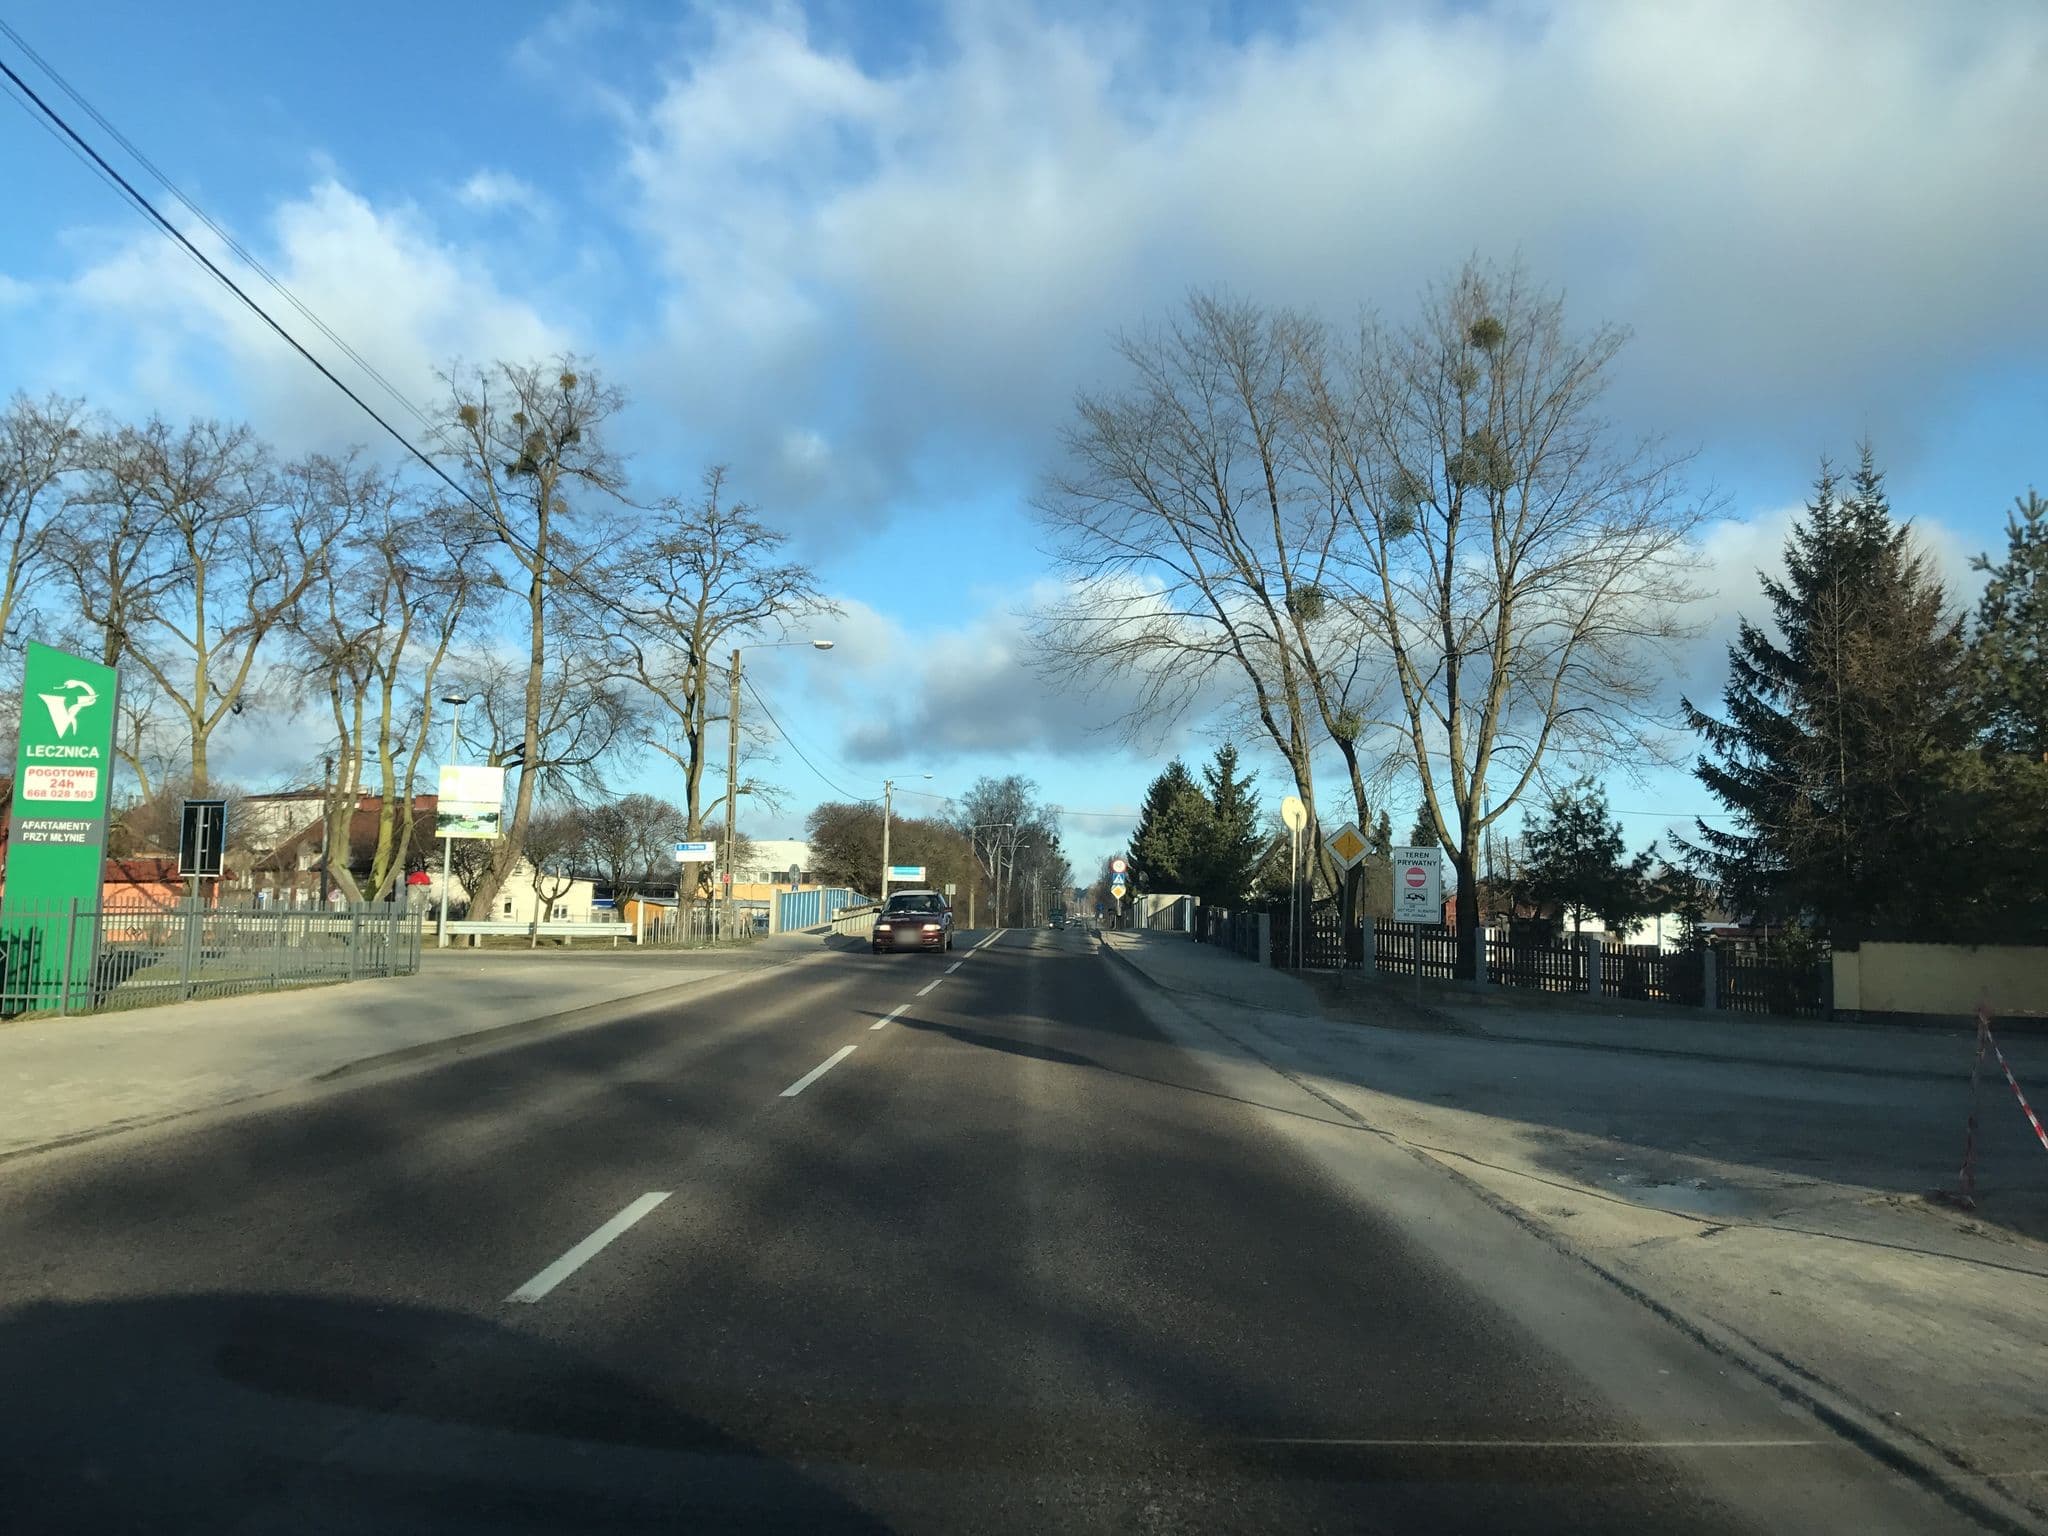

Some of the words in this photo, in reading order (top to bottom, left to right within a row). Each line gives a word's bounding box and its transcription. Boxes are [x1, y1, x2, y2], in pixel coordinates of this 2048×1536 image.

[26, 745, 100, 758] LECZNICA
[28, 768, 96, 778] POGOTOWIE
[49, 779, 74, 789] 24h
[21, 821, 92, 831] APARTAMENTY
[23, 832, 49, 842] PRZY
[49, 833, 86, 843] MŁYNIE
